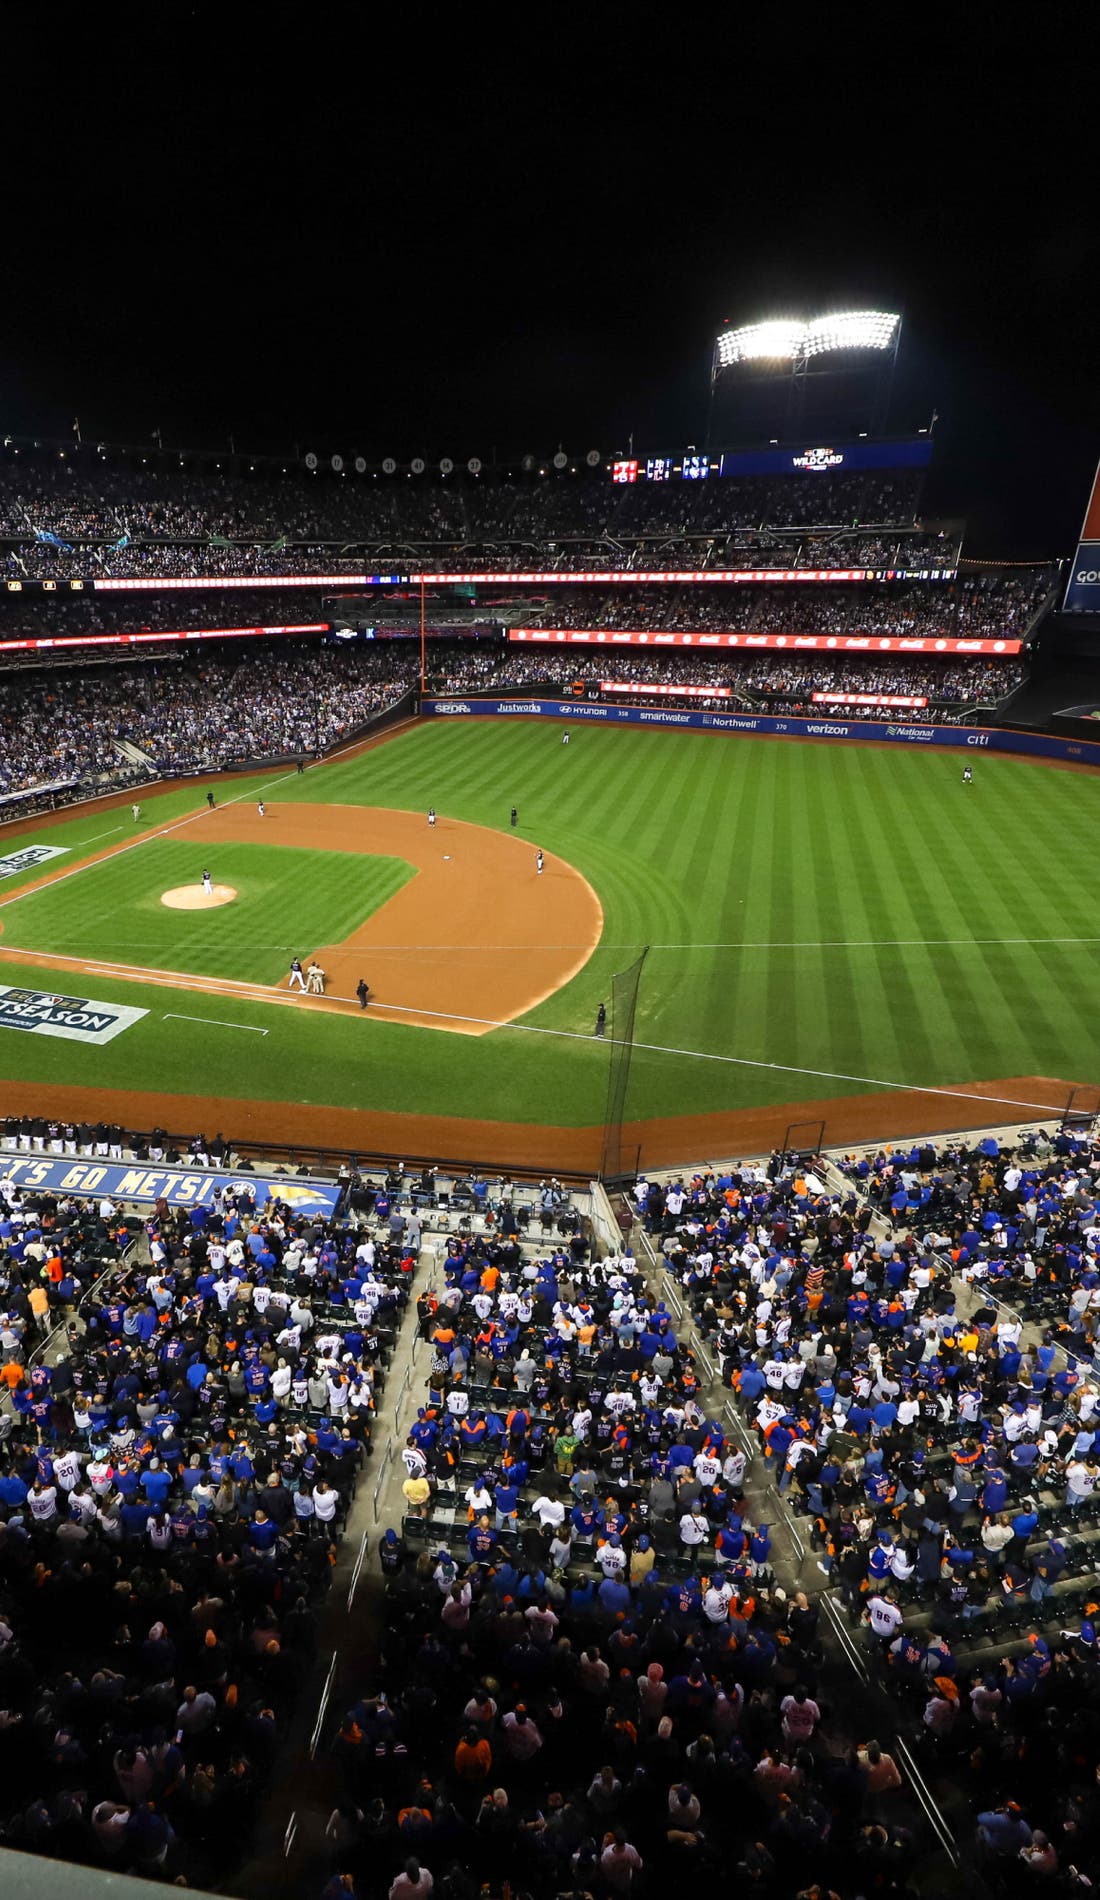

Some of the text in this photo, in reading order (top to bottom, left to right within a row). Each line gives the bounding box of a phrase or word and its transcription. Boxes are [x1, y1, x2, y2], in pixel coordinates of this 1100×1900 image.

[792, 454, 843, 466] WILD CARD
[1077, 571, 1100, 583] GO
[497, 703, 540, 713] Justworks
[573, 706, 607, 717] HYUNDAI
[639, 711, 690, 723] smartwater
[711, 717, 757, 729] Northwell
[776, 723, 788, 731] 370
[806, 723, 848, 735] verizon
[896, 727, 935, 739] National
[0, 1158, 54, 1184] T'S
[60, 1165, 108, 1189] GO
[114, 1170, 215, 1200] METS!
[766, 1410, 778, 1419] 57
[407, 1459, 416, 1468] 17
[60, 1466, 74, 1477] 20
[1084, 1477, 1096, 1485] 20
[876, 1610, 890, 1623] 86
